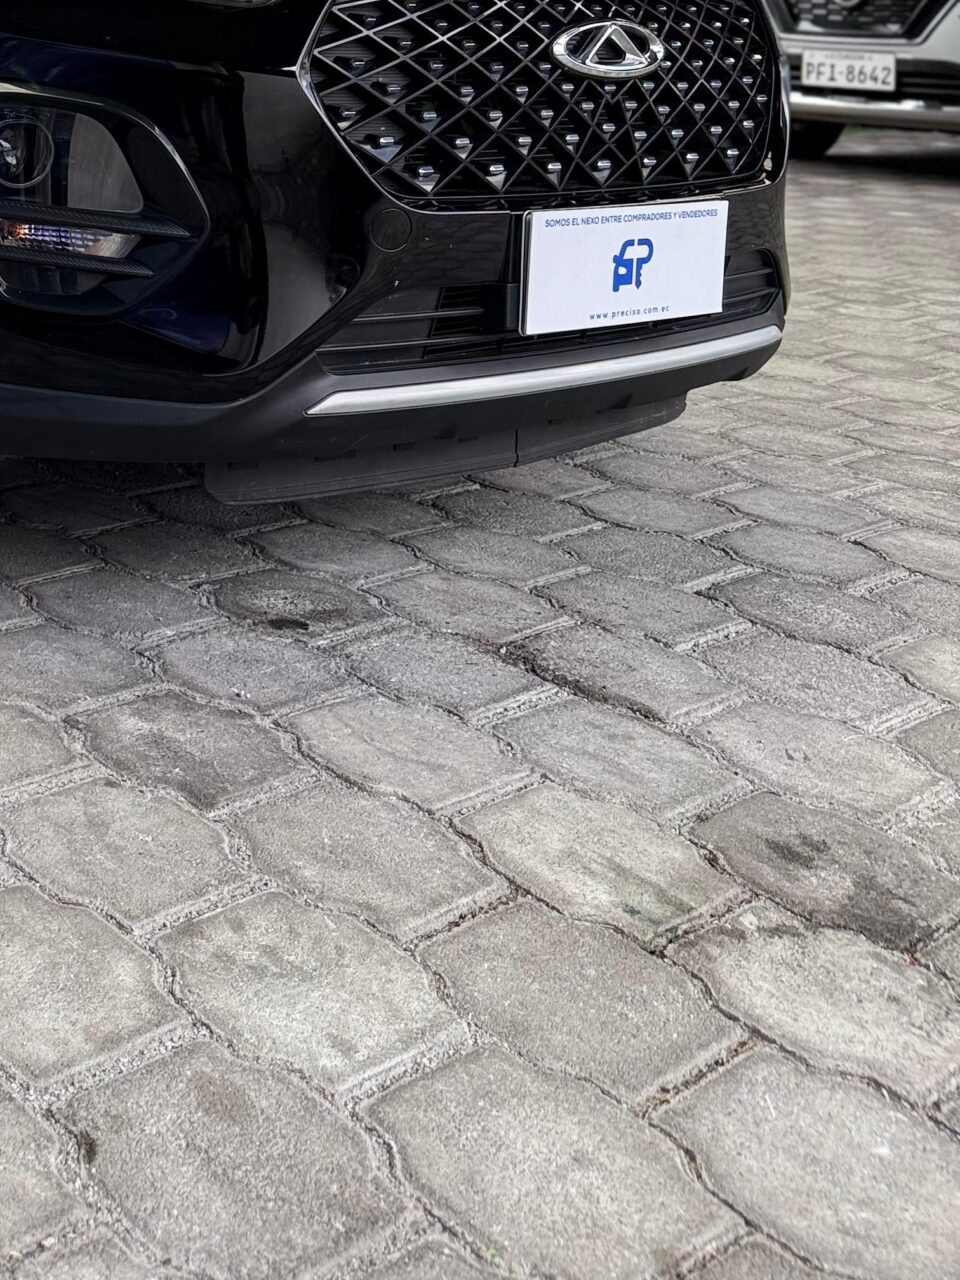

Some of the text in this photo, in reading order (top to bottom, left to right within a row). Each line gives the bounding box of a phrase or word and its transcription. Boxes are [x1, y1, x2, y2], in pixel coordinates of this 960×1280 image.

[805, 61, 893, 87] PFI-8642
[544, 208, 719, 228] SOMOS EL NEXO ENTRE COMPRADORES Y VENDEDORES
